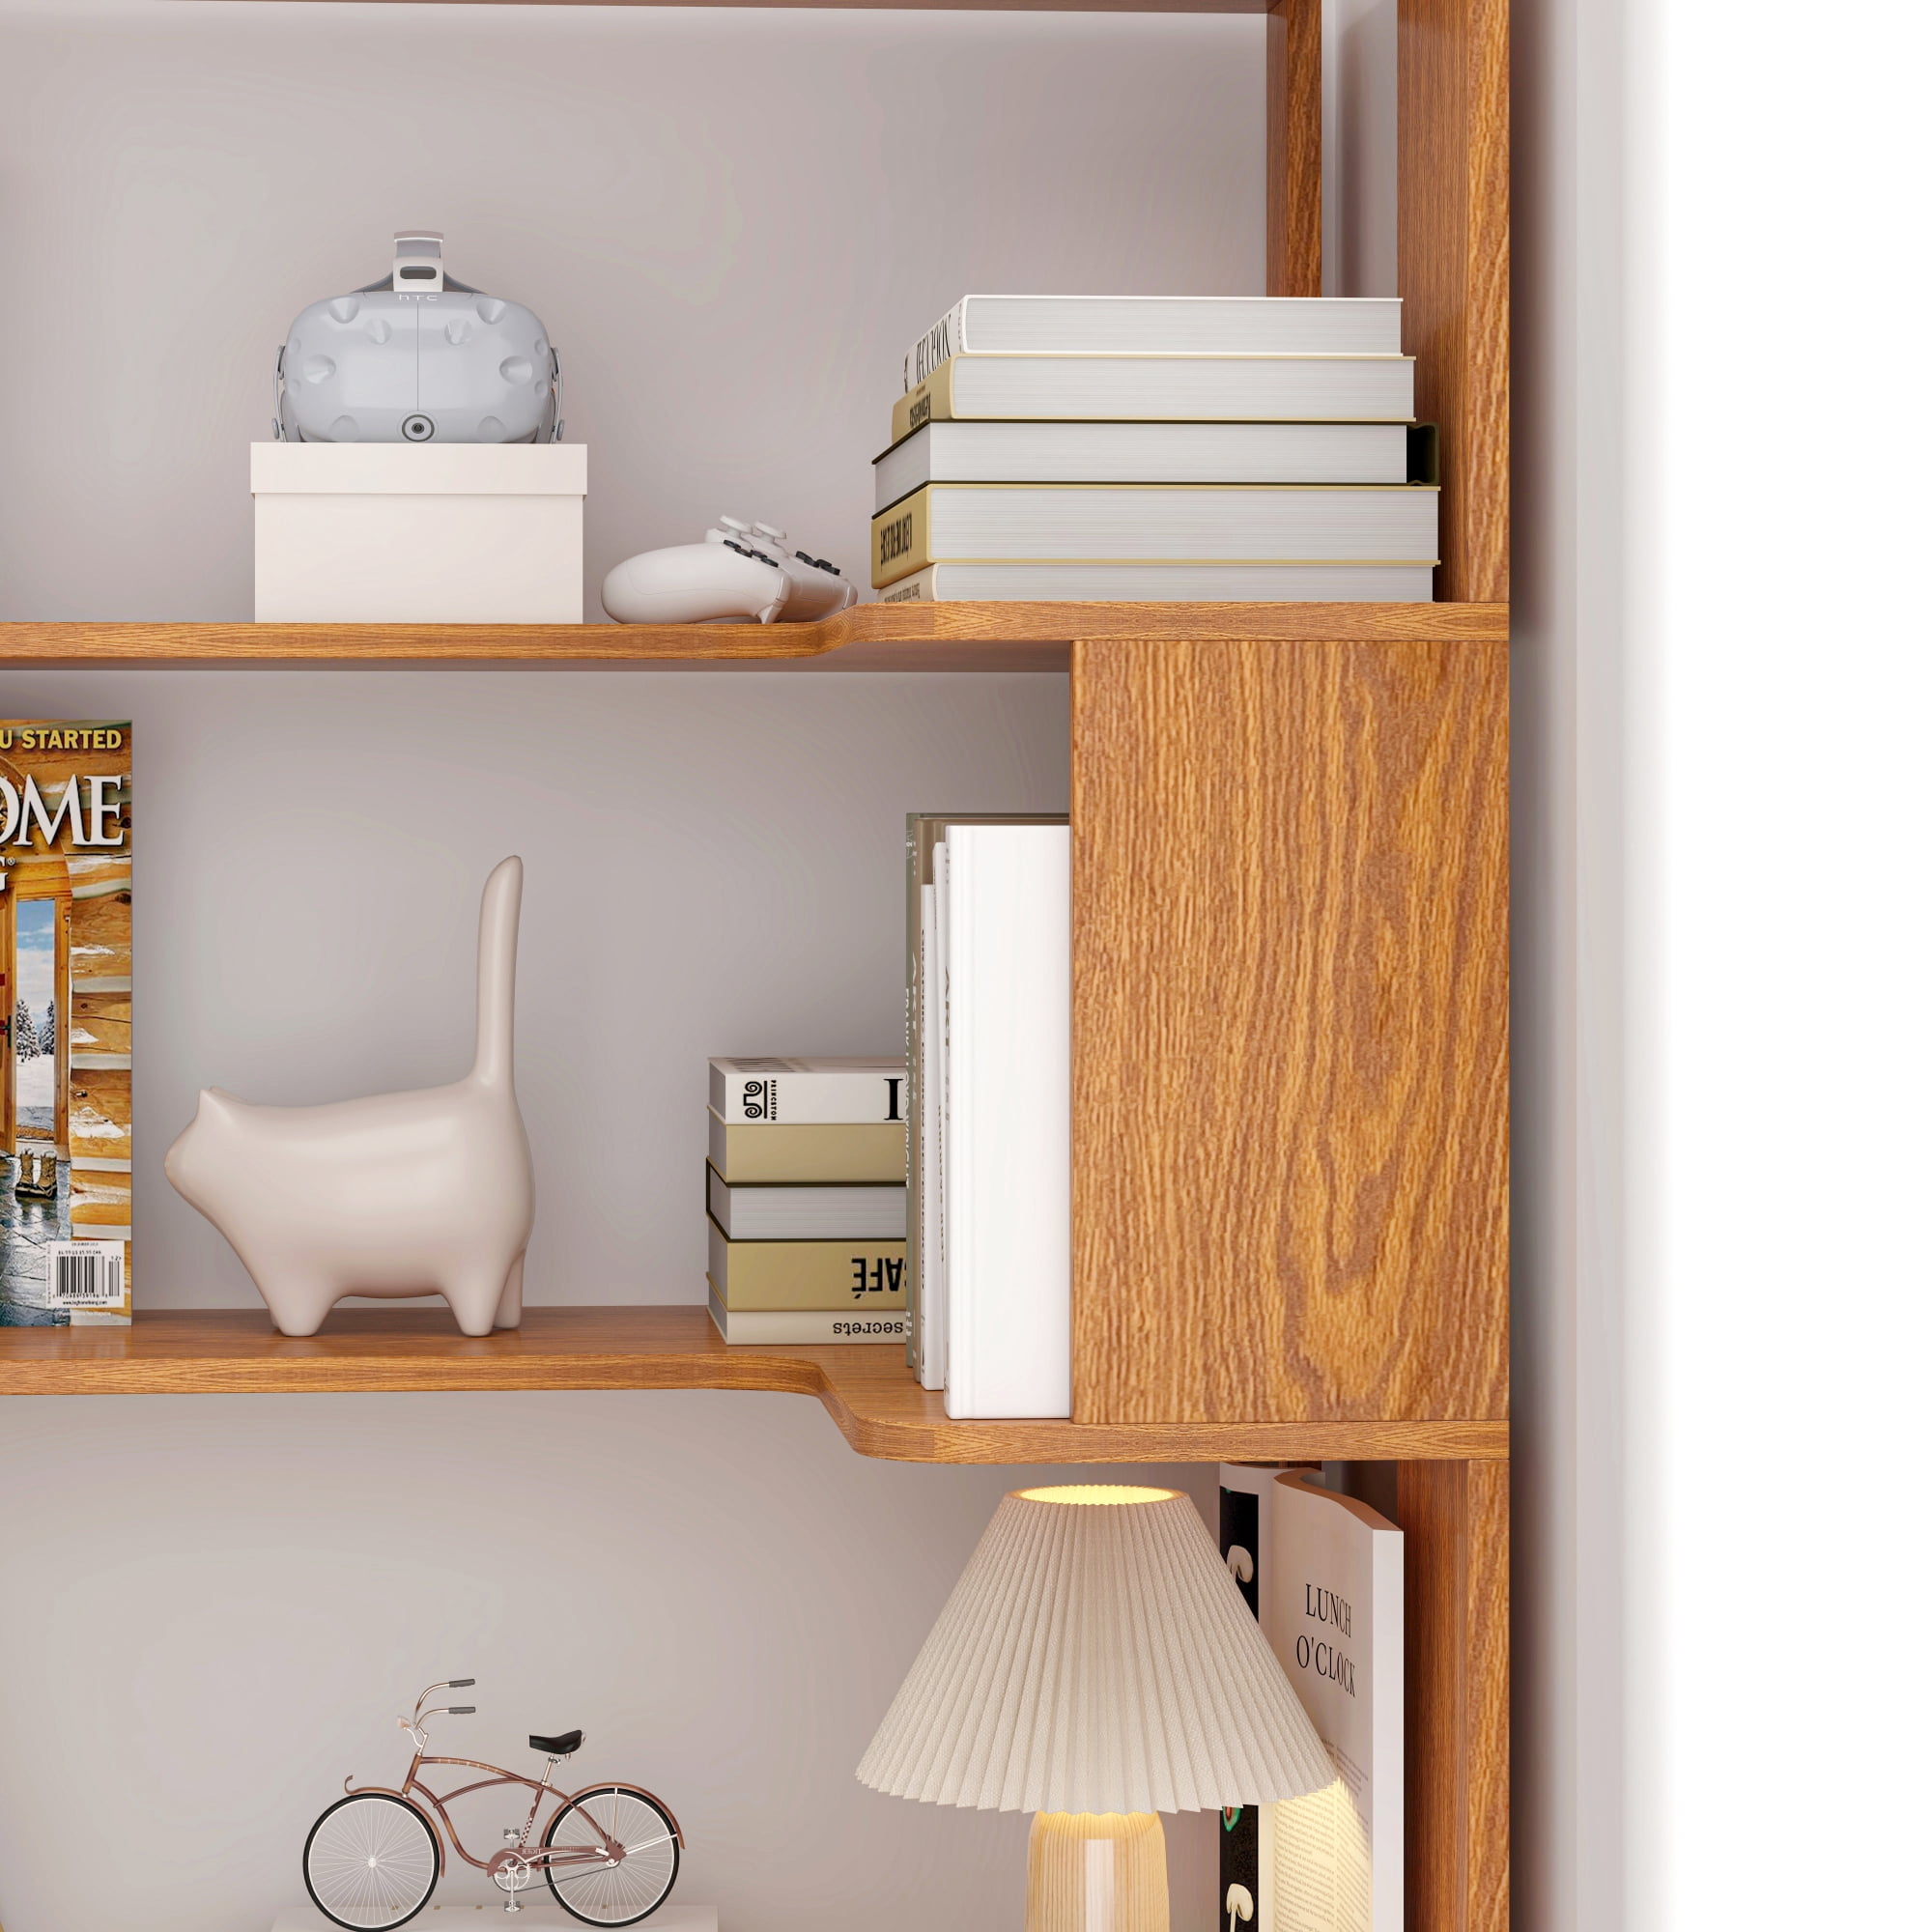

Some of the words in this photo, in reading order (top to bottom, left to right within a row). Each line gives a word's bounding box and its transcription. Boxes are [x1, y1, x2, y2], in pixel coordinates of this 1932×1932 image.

[21, 729, 123, 750] STARTED
[851, 1258, 906, 1299] AFÉ
[833, 1321, 904, 1337] secrets
[1305, 1582, 1352, 1639] LUNCH
[1295, 1634, 1356, 1699] O'CLOCK
